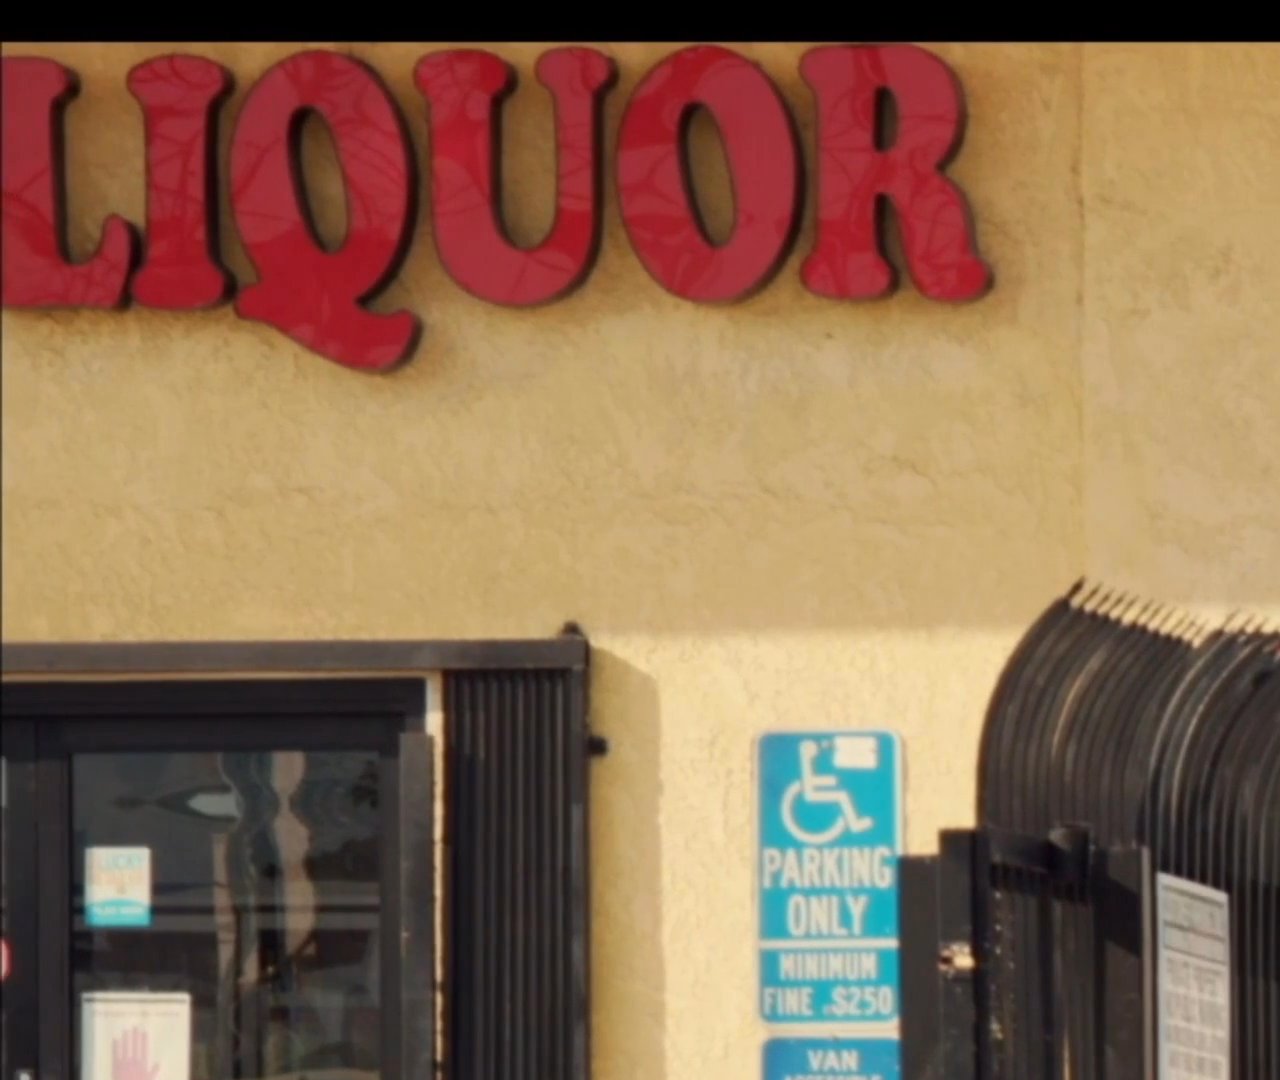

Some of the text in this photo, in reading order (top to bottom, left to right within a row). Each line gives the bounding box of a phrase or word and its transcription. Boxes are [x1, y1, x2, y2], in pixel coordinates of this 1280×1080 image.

[2, 44, 993, 371] LIQUOR
[763, 848, 894, 889] PARKING
[787, 894, 869, 936] ONLY
[780, 952, 877, 980] MINIMUM
[763, 986, 813, 1016] FINE
[807, 1049, 860, 1072] VAN
